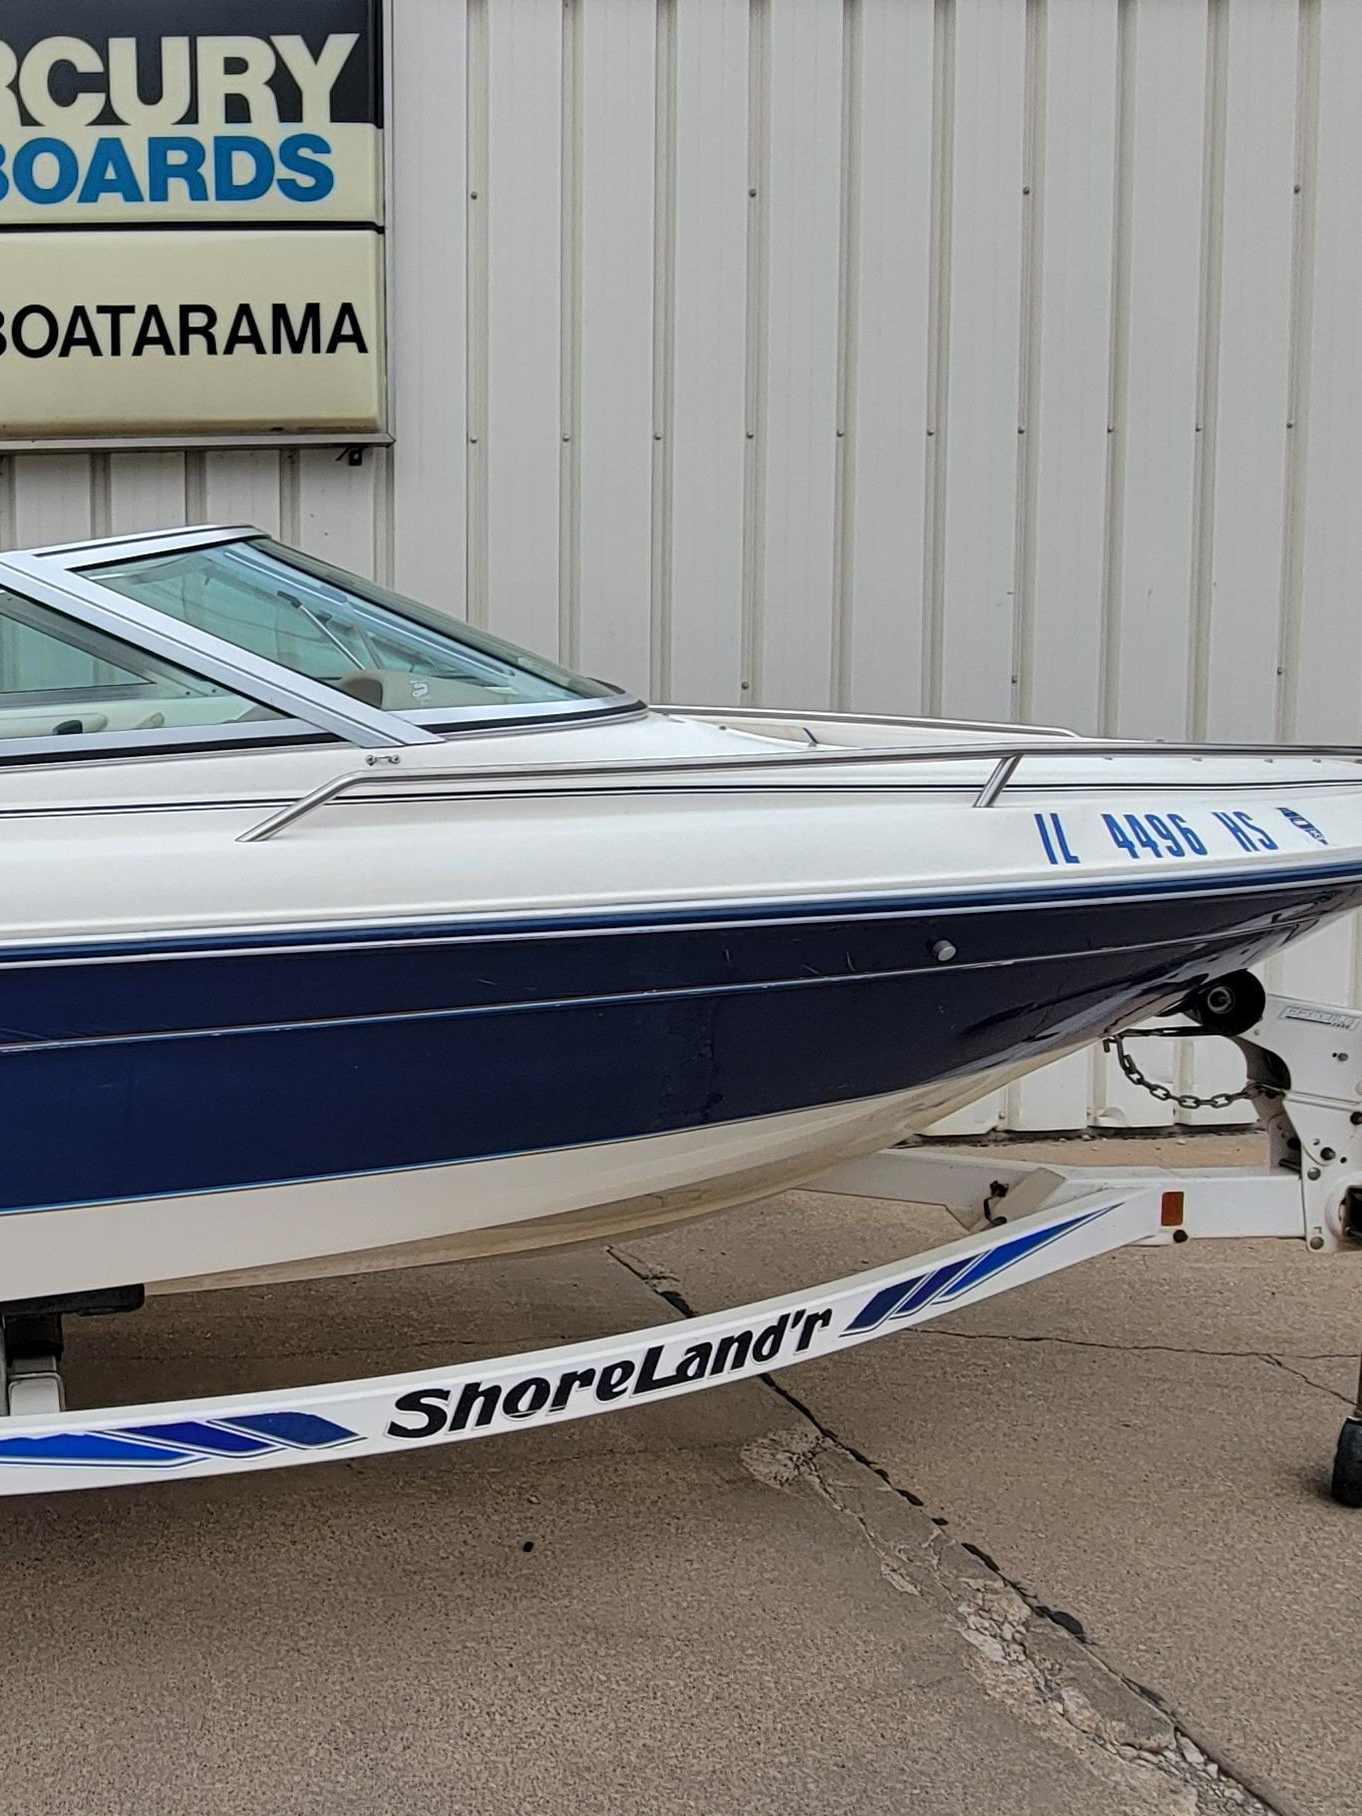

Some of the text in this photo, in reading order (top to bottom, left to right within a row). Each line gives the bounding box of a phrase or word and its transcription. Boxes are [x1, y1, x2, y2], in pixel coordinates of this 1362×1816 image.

[1033, 812, 1081, 865] IL
[1100, 813, 1209, 860] 4496
[1211, 810, 1280, 852] HS
